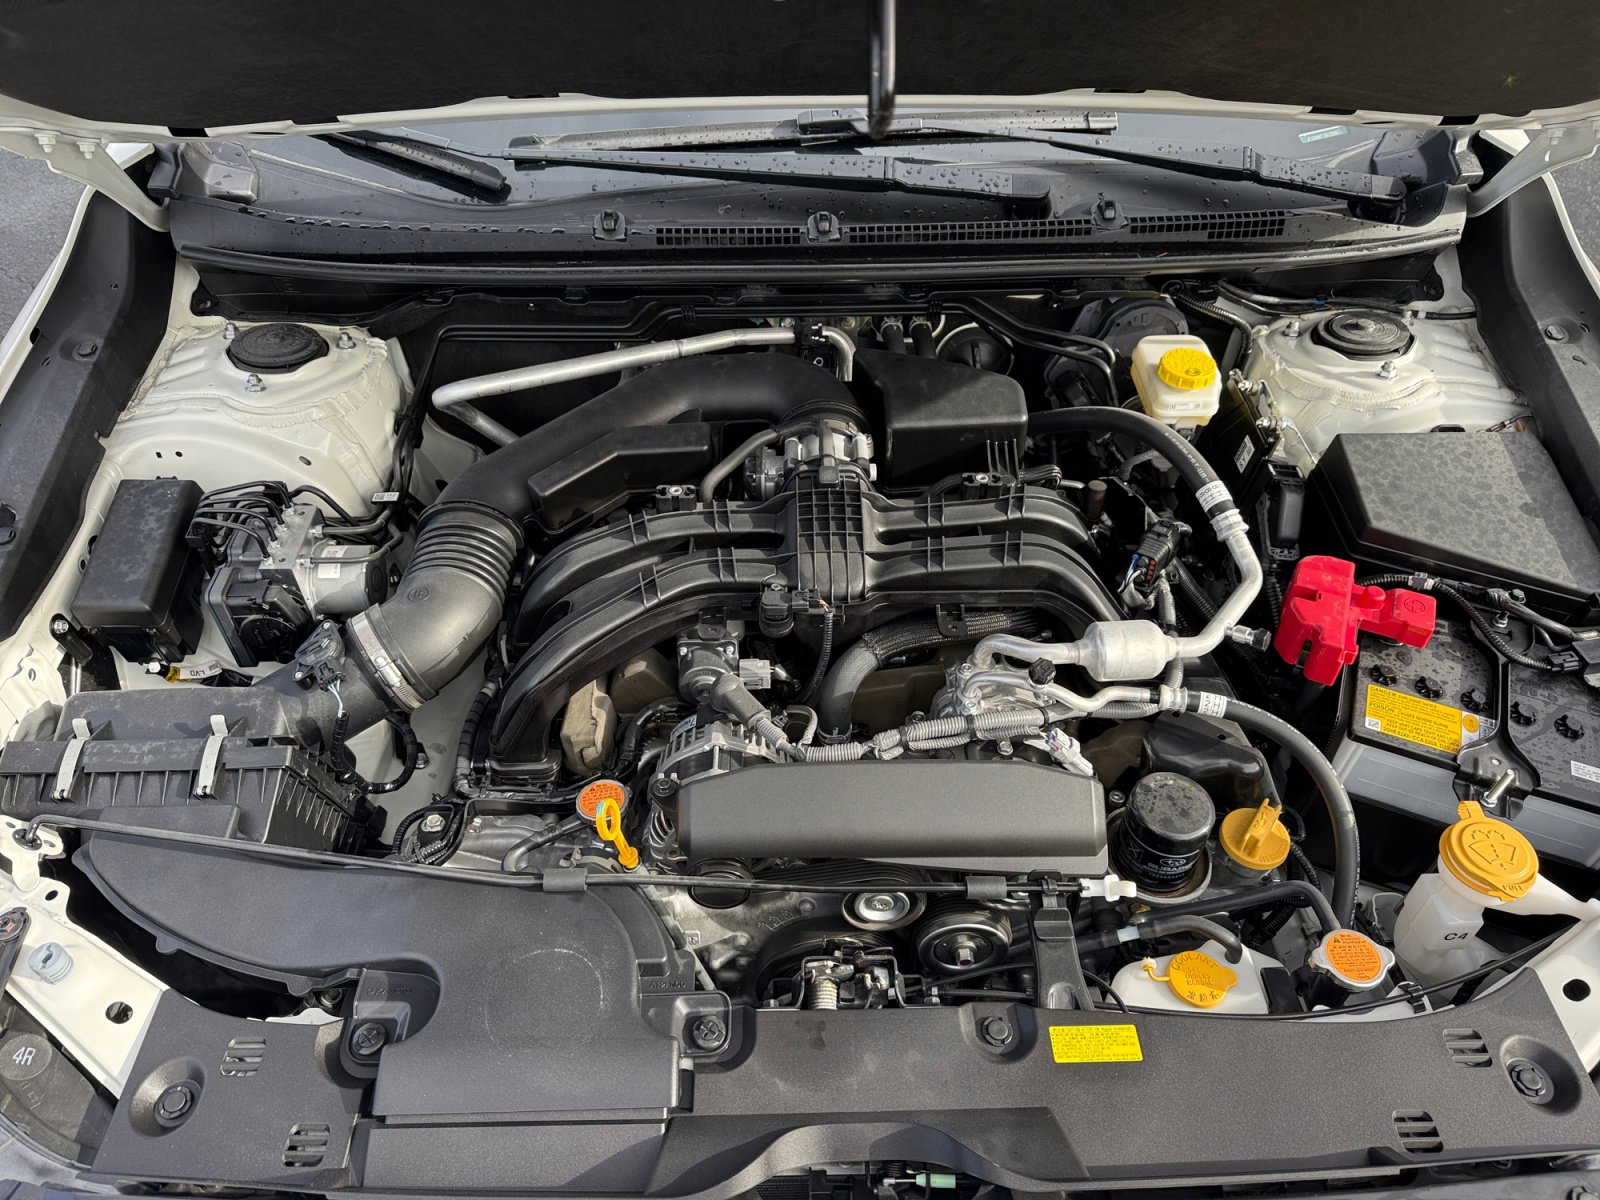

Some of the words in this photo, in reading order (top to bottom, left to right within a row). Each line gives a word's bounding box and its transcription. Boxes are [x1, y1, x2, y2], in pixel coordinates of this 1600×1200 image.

[1371, 687, 1396, 697] DANGER
[1369, 702, 1394, 712] POISON
[1444, 932, 1468, 941] C4
[1171, 953, 1219, 970] COOLANT
[12, 1046, 36, 1066] 4R
